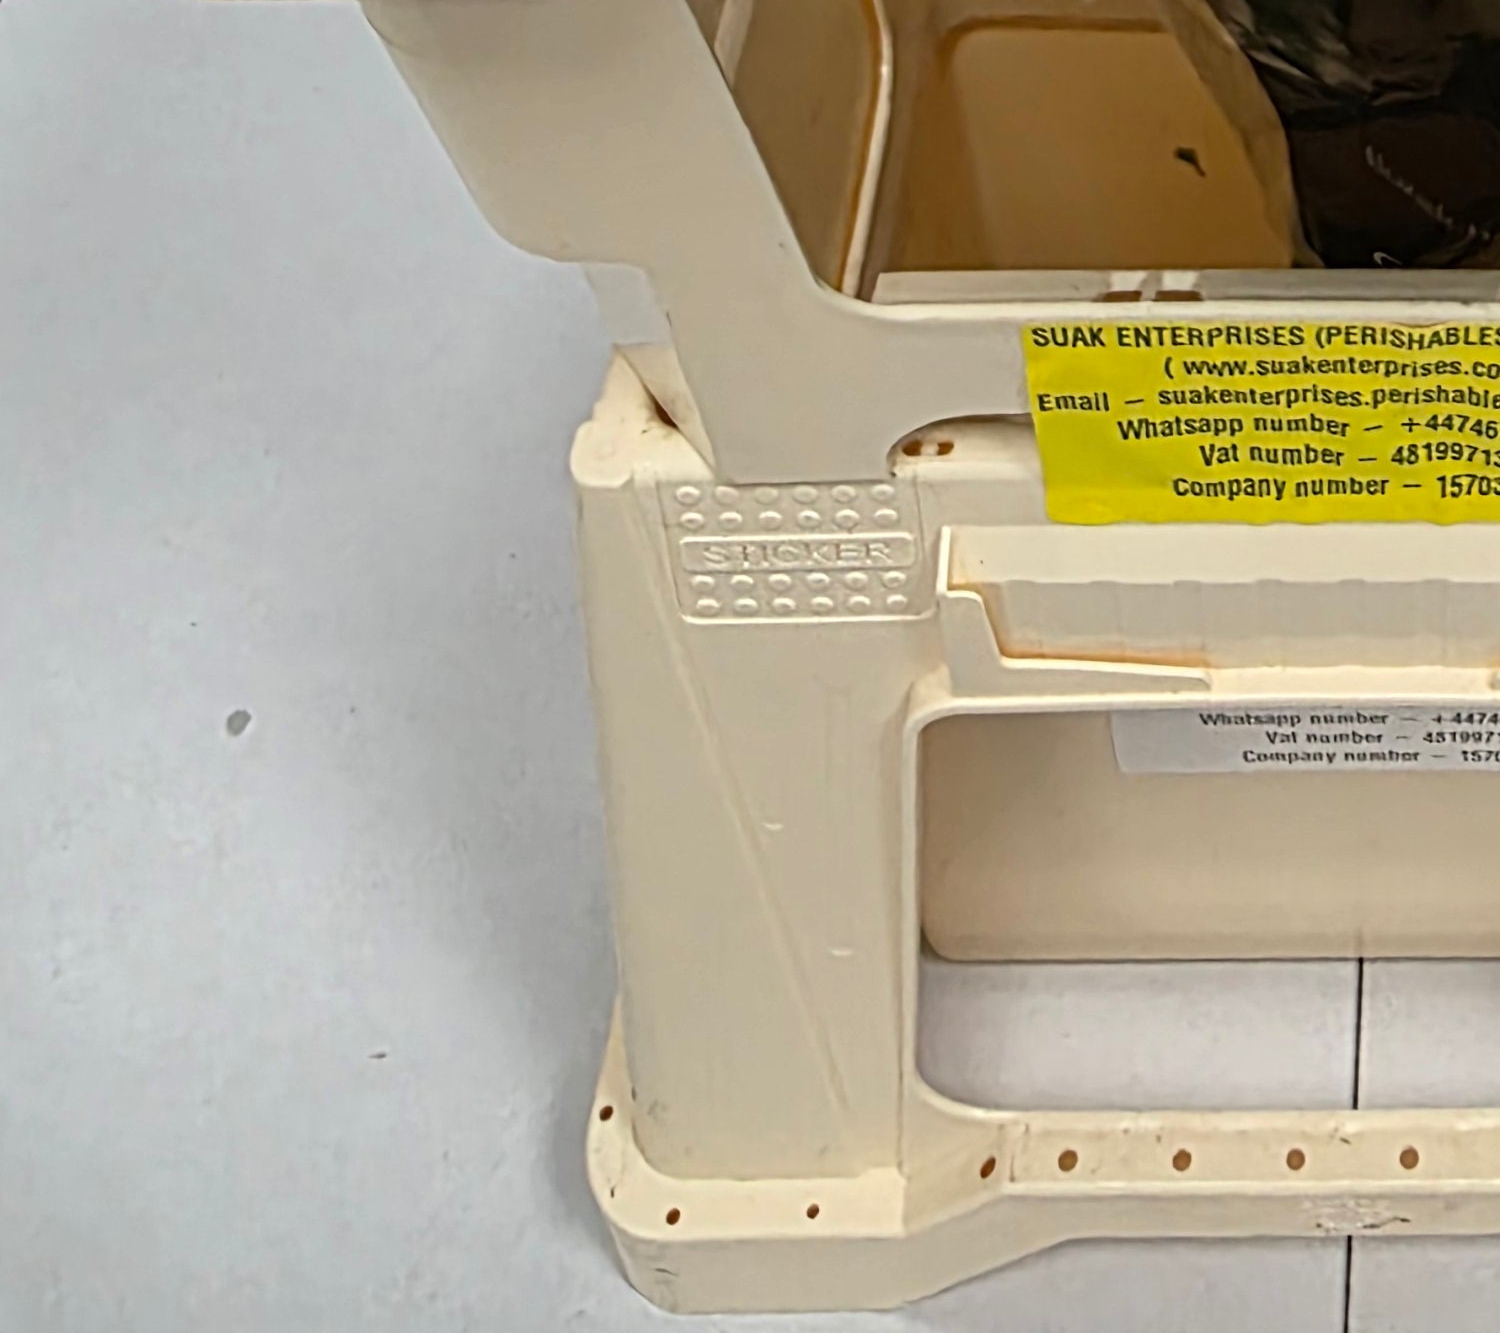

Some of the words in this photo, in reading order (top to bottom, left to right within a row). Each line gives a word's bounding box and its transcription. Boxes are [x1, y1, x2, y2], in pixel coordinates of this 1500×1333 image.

[1032, 326, 1106, 348] SUAK
[1117, 325, 1305, 348] ENTERPRISES
[1037, 391, 1110, 412] Email
[1117, 415, 1244, 441] Whatsapp
[1253, 413, 1350, 437] number
[1199, 443, 1240, 466] Vat
[1249, 443, 1345, 466] number
[1173, 477, 1287, 501] Company
[1295, 477, 1390, 498] number
[702, 541, 895, 569] STICKER
[1199, 712, 1301, 727] Whatsapp
[1309, 712, 1390, 725] number
[1265, 730, 1298, 745] Vat
[1306, 731, 1384, 744] number
[1242, 750, 1337, 765] Company
[1344, 749, 1420, 762] number
